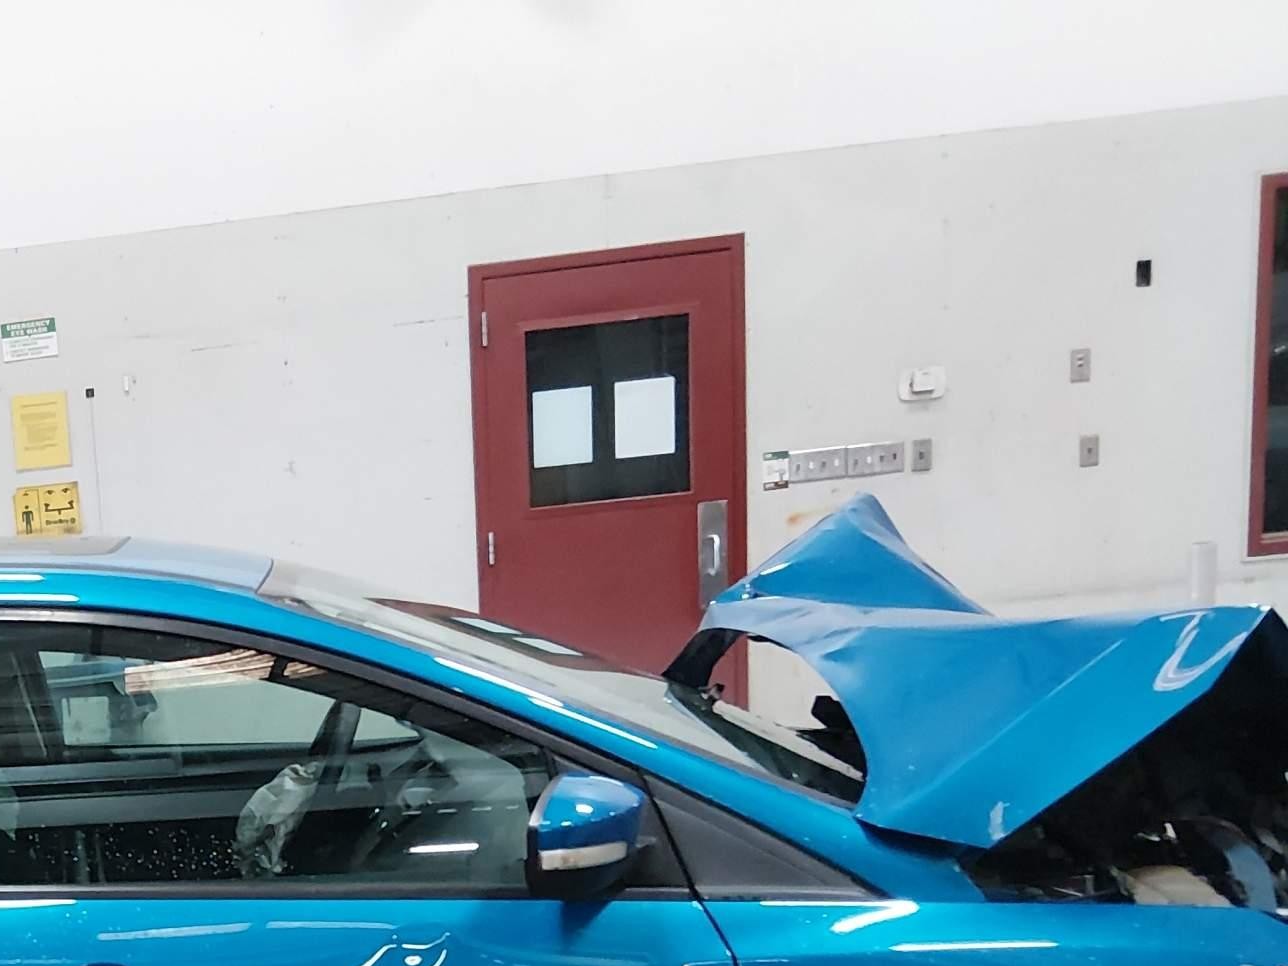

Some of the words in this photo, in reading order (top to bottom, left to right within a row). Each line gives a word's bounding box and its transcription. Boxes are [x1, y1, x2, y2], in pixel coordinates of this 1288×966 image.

[6, 319, 50, 332] EMERGENCY
[10, 329, 25, 337] EYE
[26, 326, 48, 335] WASH
